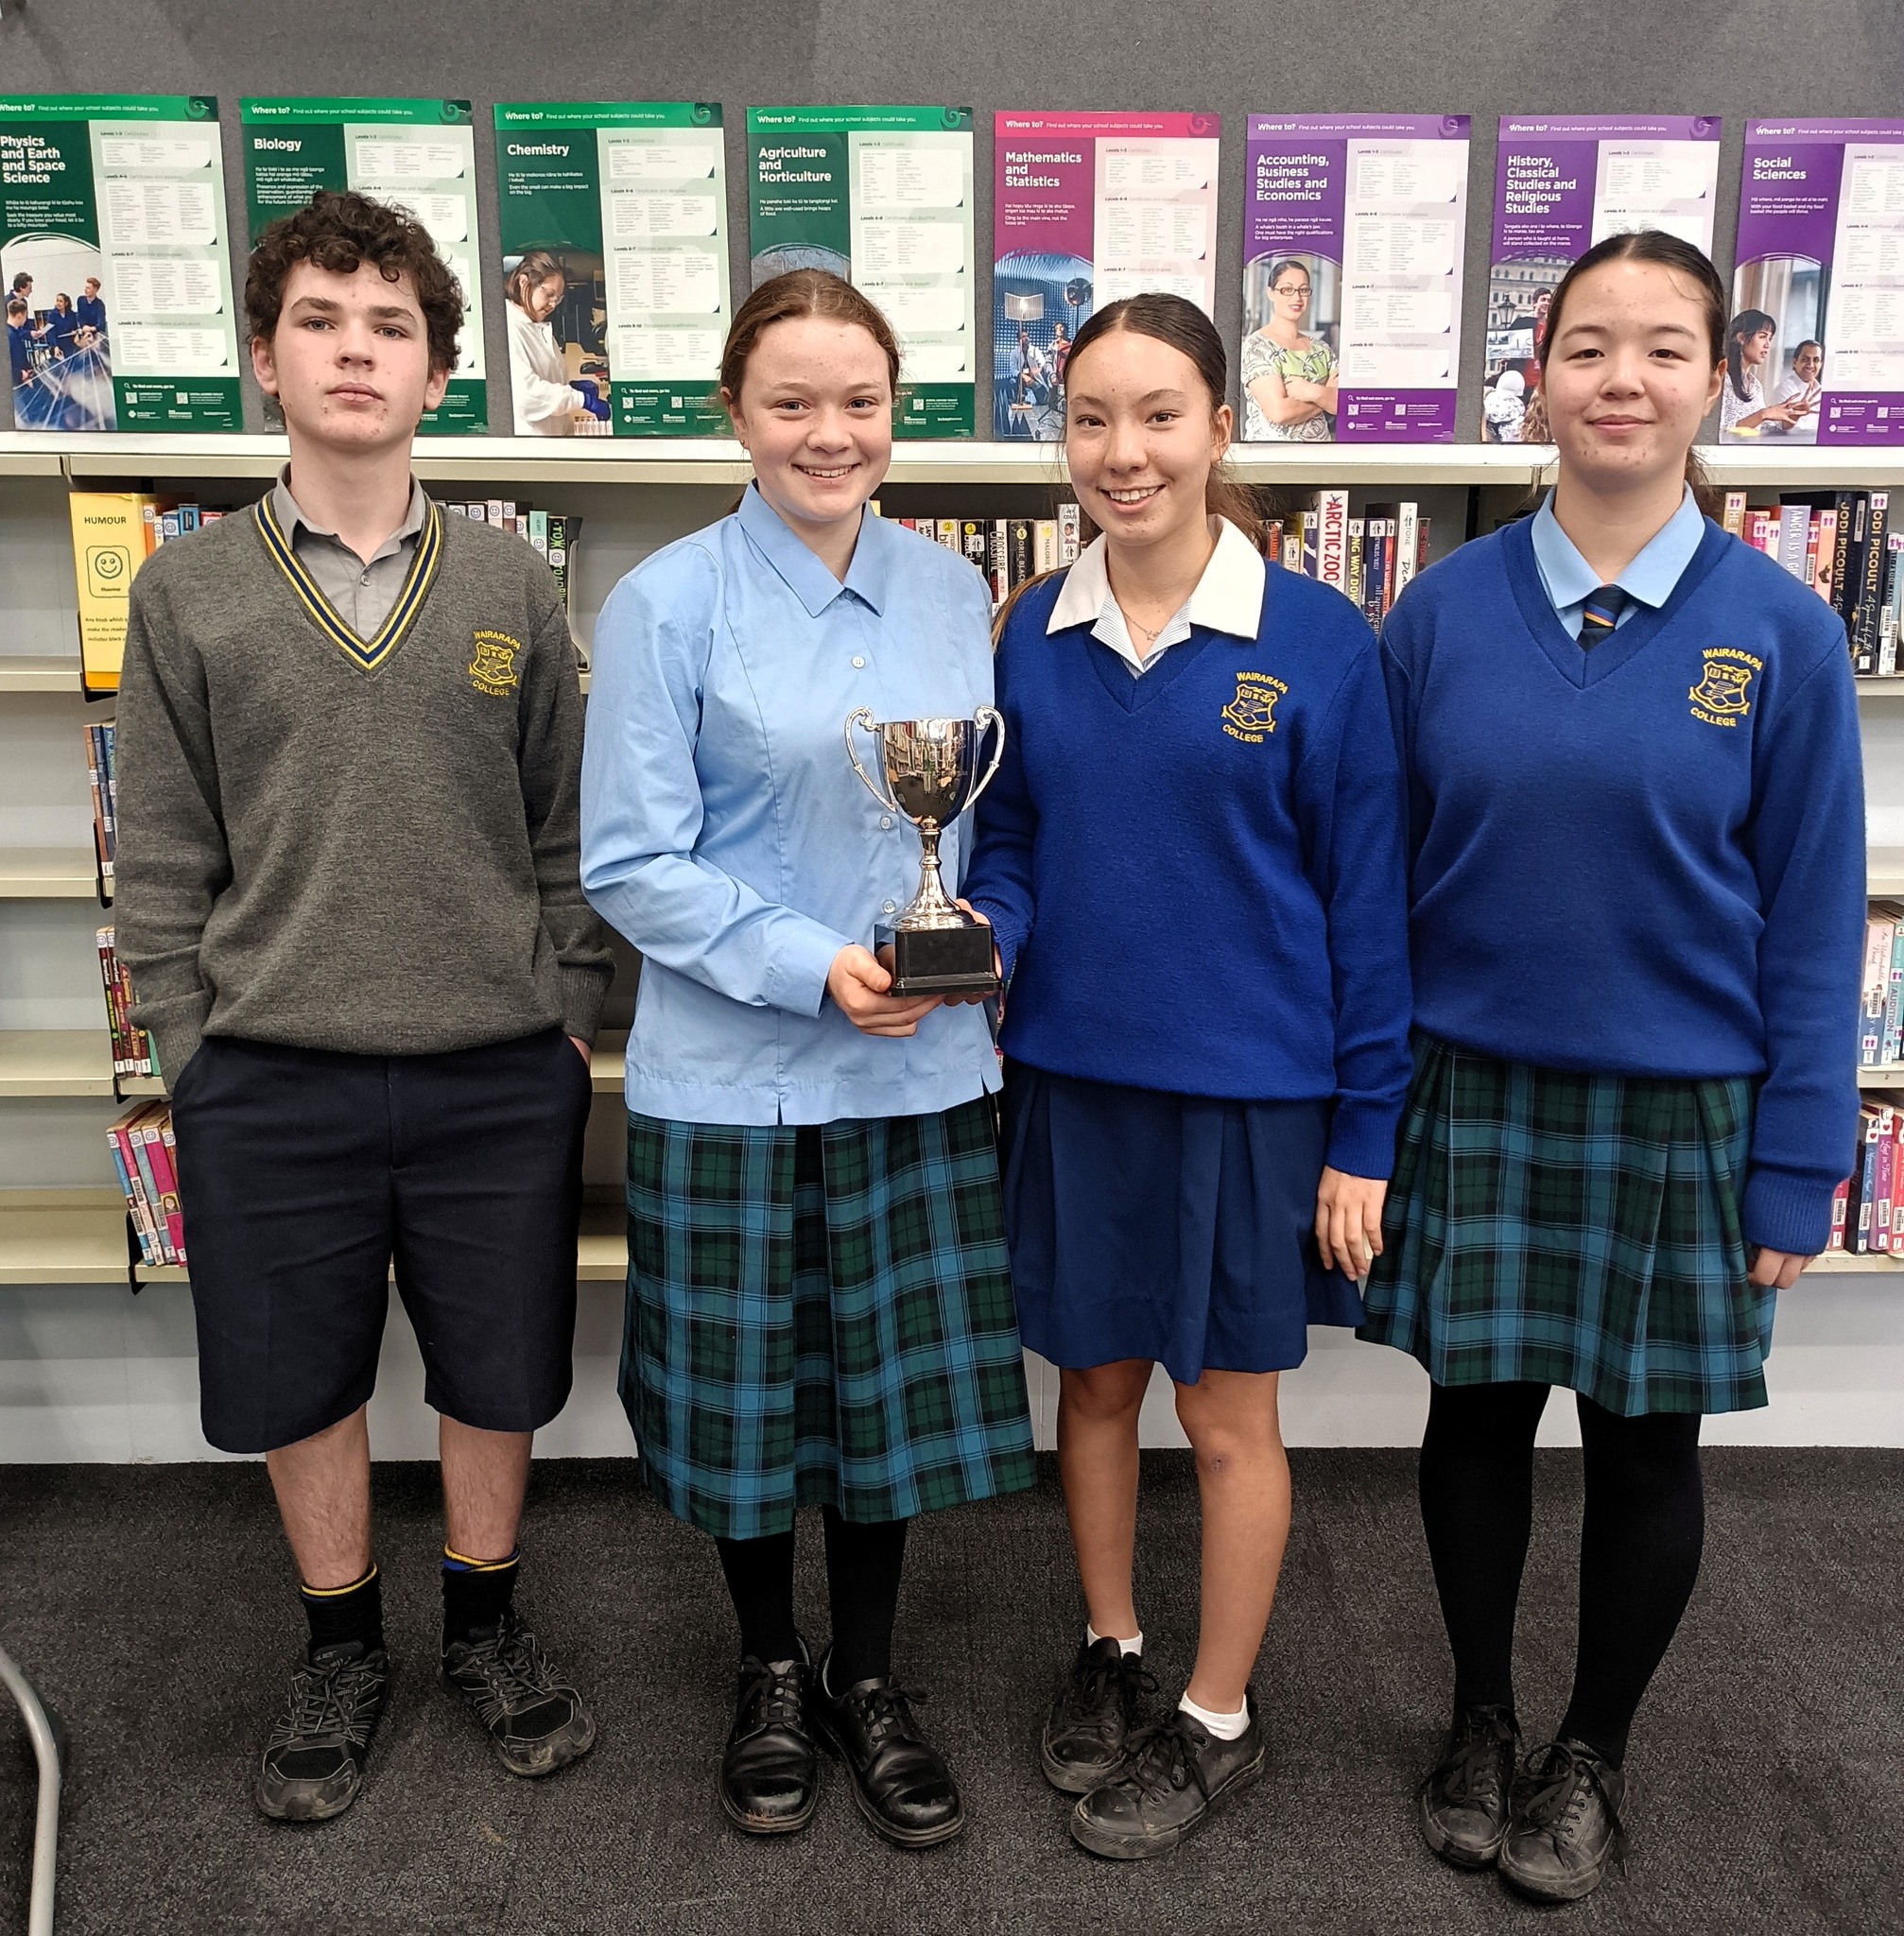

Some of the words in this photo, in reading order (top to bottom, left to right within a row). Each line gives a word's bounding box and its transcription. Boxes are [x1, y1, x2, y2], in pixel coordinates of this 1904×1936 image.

[0, 103, 22, 112] Where
[24, 103, 35, 112] to?
[251, 105, 276, 114] Where
[278, 106, 290, 114] to?
[506, 111, 530, 120] Where
[531, 112, 543, 120] to?
[757, 115, 782, 124] Where
[784, 115, 796, 124] to?
[1006, 120, 1030, 129] Where
[1031, 120, 1044, 129] to?
[1257, 123, 1283, 131] Where
[1510, 123, 1534, 132] Where
[1757, 126, 1781, 135] Where
[1783, 127, 1795, 135] to?
[0, 135, 45, 148] Physics
[253, 138, 302, 151] Biology
[1, 147, 25, 159] and
[27, 147, 61, 159] Earth
[507, 144, 569, 157] Chemistry
[758, 147, 826, 160] Agriculture
[1005, 151, 1082, 163] Mathematics
[1257, 154, 1329, 166] Accounting,
[1508, 155, 1553, 167] History,
[1754, 157, 1791, 168] Social
[2, 160, 26, 171] and
[28, 160, 66, 172] Space
[758, 159, 782, 170] and
[1005, 164, 1028, 174] and
[3, 172, 50, 183] Science
[759, 171, 832, 182] Horticulture
[1257, 166, 1309, 177] Business
[1507, 166, 1559, 178] Classical
[1753, 168, 1807, 180] Sciences
[1005, 176, 1060, 187] Statistics
[1256, 178, 1301, 189] Studies
[1305, 178, 1327, 188] and
[1506, 179, 1551, 190] Studies
[1553, 179, 1577, 190] and
[1256, 189, 1322, 200] Economics
[1506, 191, 1562, 203] Religious
[1505, 202, 1549, 214] Studies
[84, 516, 127, 525] HUMOUR
[1728, 510, 1740, 524] HE
[1839, 501, 1850, 533] JODI
[1871, 510, 1883, 534] ODI
[1324, 501, 1342, 550] ARCTIC
[1788, 510, 1804, 539] ANGER
[1351, 535, 1360, 552] ONG
[1788, 542, 1800, 551] IS
[990, 531, 1006, 573] CROSSFIRE
[1373, 537, 1381, 570] EYNOLDS/KIELY
[1324, 554, 1341, 580] ZOO
[1350, 555, 1360, 577] WAY
[1834, 537, 1847, 591] PICOULT
[1866, 538, 1881, 592] PICOULT
[1401, 559, 1411, 586] Dea
[1349, 579, 1359, 604] DOW
[1861, 603, 1875, 626] Spark
[474, 631, 521, 649] WAIRARAPA
[1702, 648, 1763, 670] WAIRARAPA
[473, 680, 510, 696] COLLEGE
[1237, 672, 1289, 694] WAIRARAPA
[1690, 707, 1737, 727] COLLEGE
[1222, 724, 1263, 743] COLLEGE
[1886, 988, 1898, 1032] AUDITION
[1881, 1164, 1890, 1182] Time
